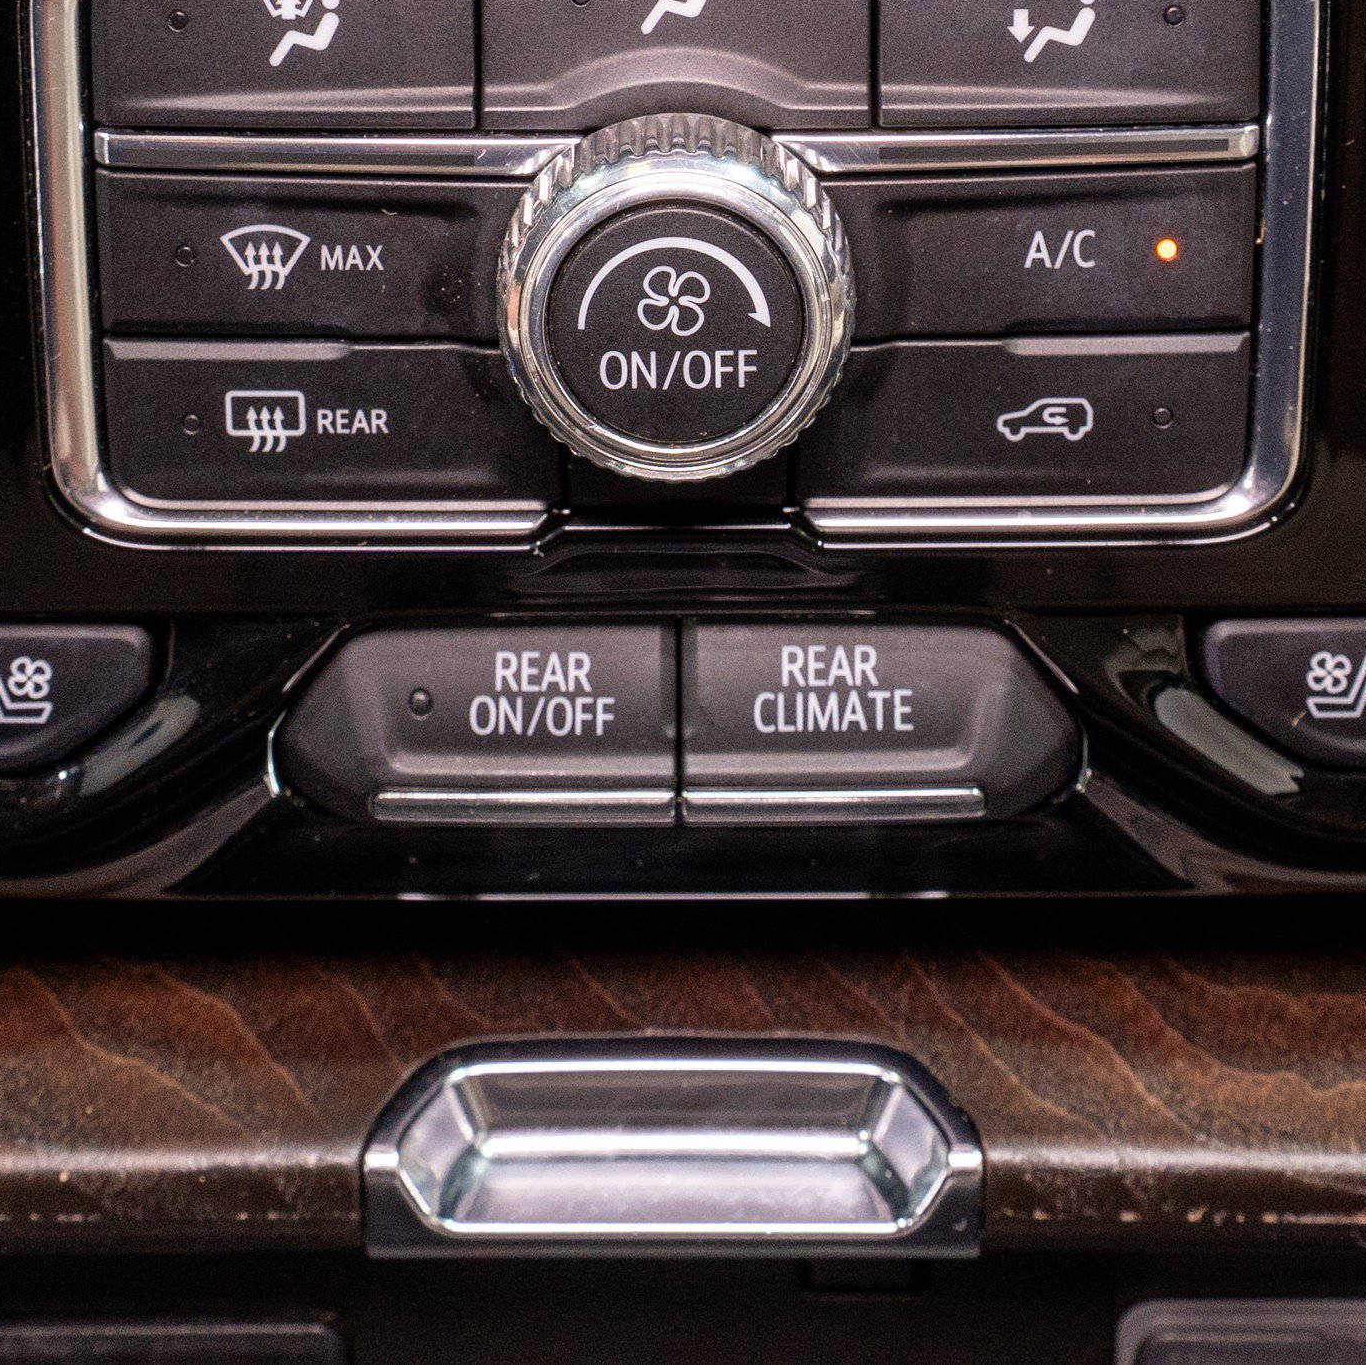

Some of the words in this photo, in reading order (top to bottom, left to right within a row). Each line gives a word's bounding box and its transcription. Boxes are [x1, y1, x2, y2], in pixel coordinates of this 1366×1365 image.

[320, 243, 385, 272] MAX
[1024, 228, 1097, 271] A/C
[597, 349, 759, 392] ON/OFF
[316, 407, 390, 436] REAR
[494, 650, 592, 694] REAR
[780, 644, 880, 688] REAR
[468, 695, 616, 738] ON/OFF
[753, 689, 914, 734] CLIMATE
